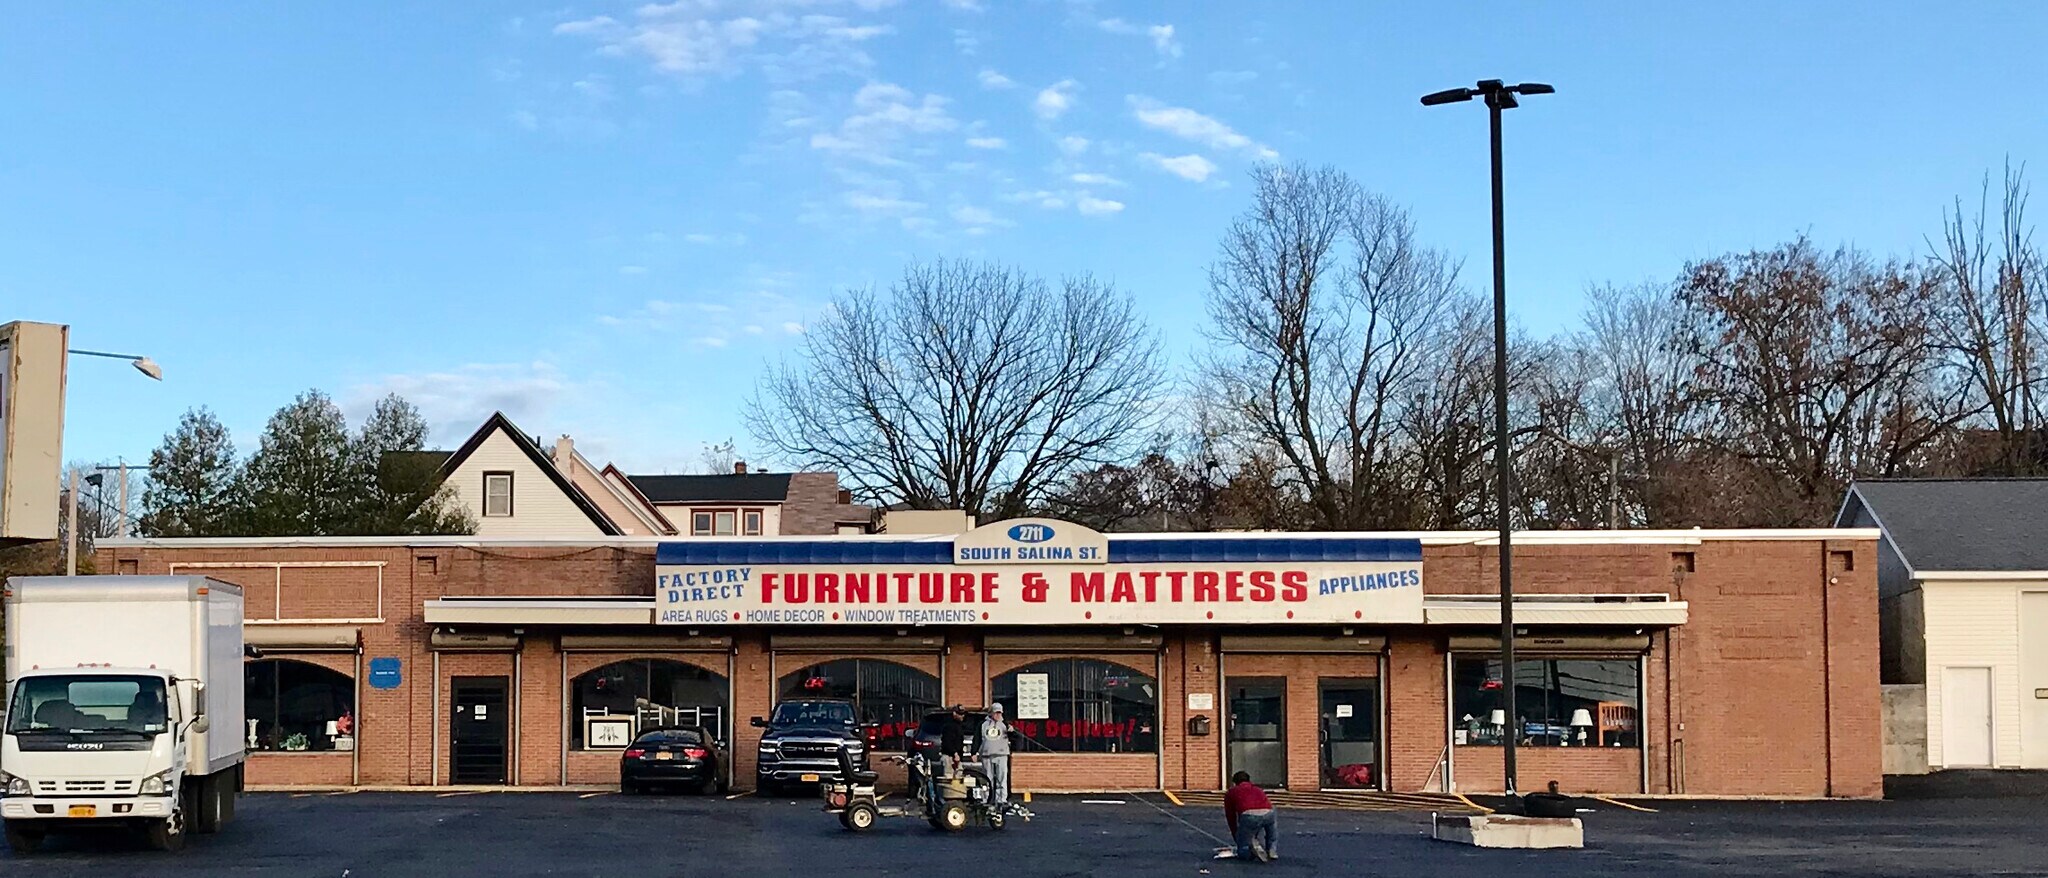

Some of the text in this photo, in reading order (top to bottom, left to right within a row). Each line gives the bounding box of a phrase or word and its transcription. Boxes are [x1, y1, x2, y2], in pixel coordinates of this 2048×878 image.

[1019, 526, 1044, 541] 2711
[960, 546, 1102, 560] SOUTH SALINA ST.
[658, 568, 751, 588] FACTORY
[761, 571, 1308, 603] FURNITURE & MATTRESS
[1319, 569, 1419, 595] APPLIANCES
[668, 584, 744, 603] DIRECT
[662, 609, 976, 622] AREA RUGS HOME DECOR WINDOW TREATMENTS
